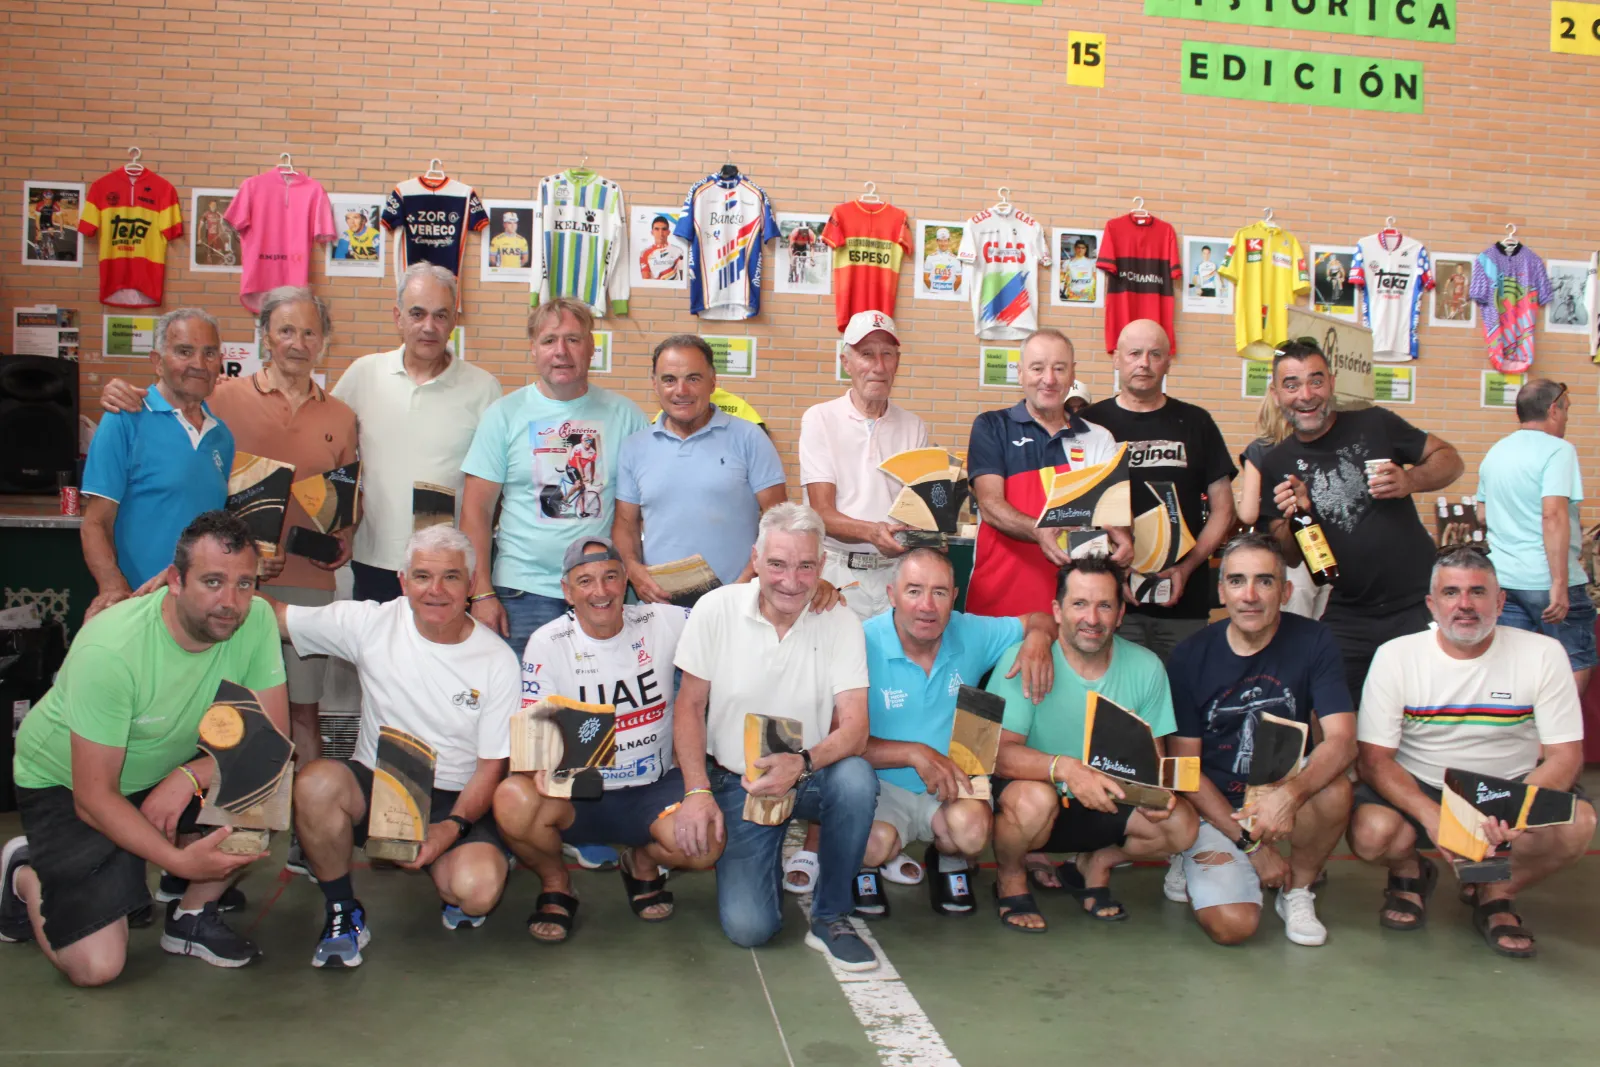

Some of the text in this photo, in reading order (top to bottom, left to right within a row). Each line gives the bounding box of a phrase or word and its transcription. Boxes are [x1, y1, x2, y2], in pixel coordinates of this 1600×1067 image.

[1190, 51, 1418, 100] EDICIÓN
[418, 211, 445, 222] ZOR
[971, 210, 992, 224] CLAS
[1015, 211, 1035, 226] CLAS
[409, 225, 456, 236] VERECO
[554, 221, 600, 234] KELME
[502, 248, 521, 256] KAS
[849, 250, 890, 264] ESPESO
[873, 314, 886, 324] R
[1046, 510, 1057, 521] La
[1090, 755, 1102, 767] La
[1476, 782, 1488, 792] La
